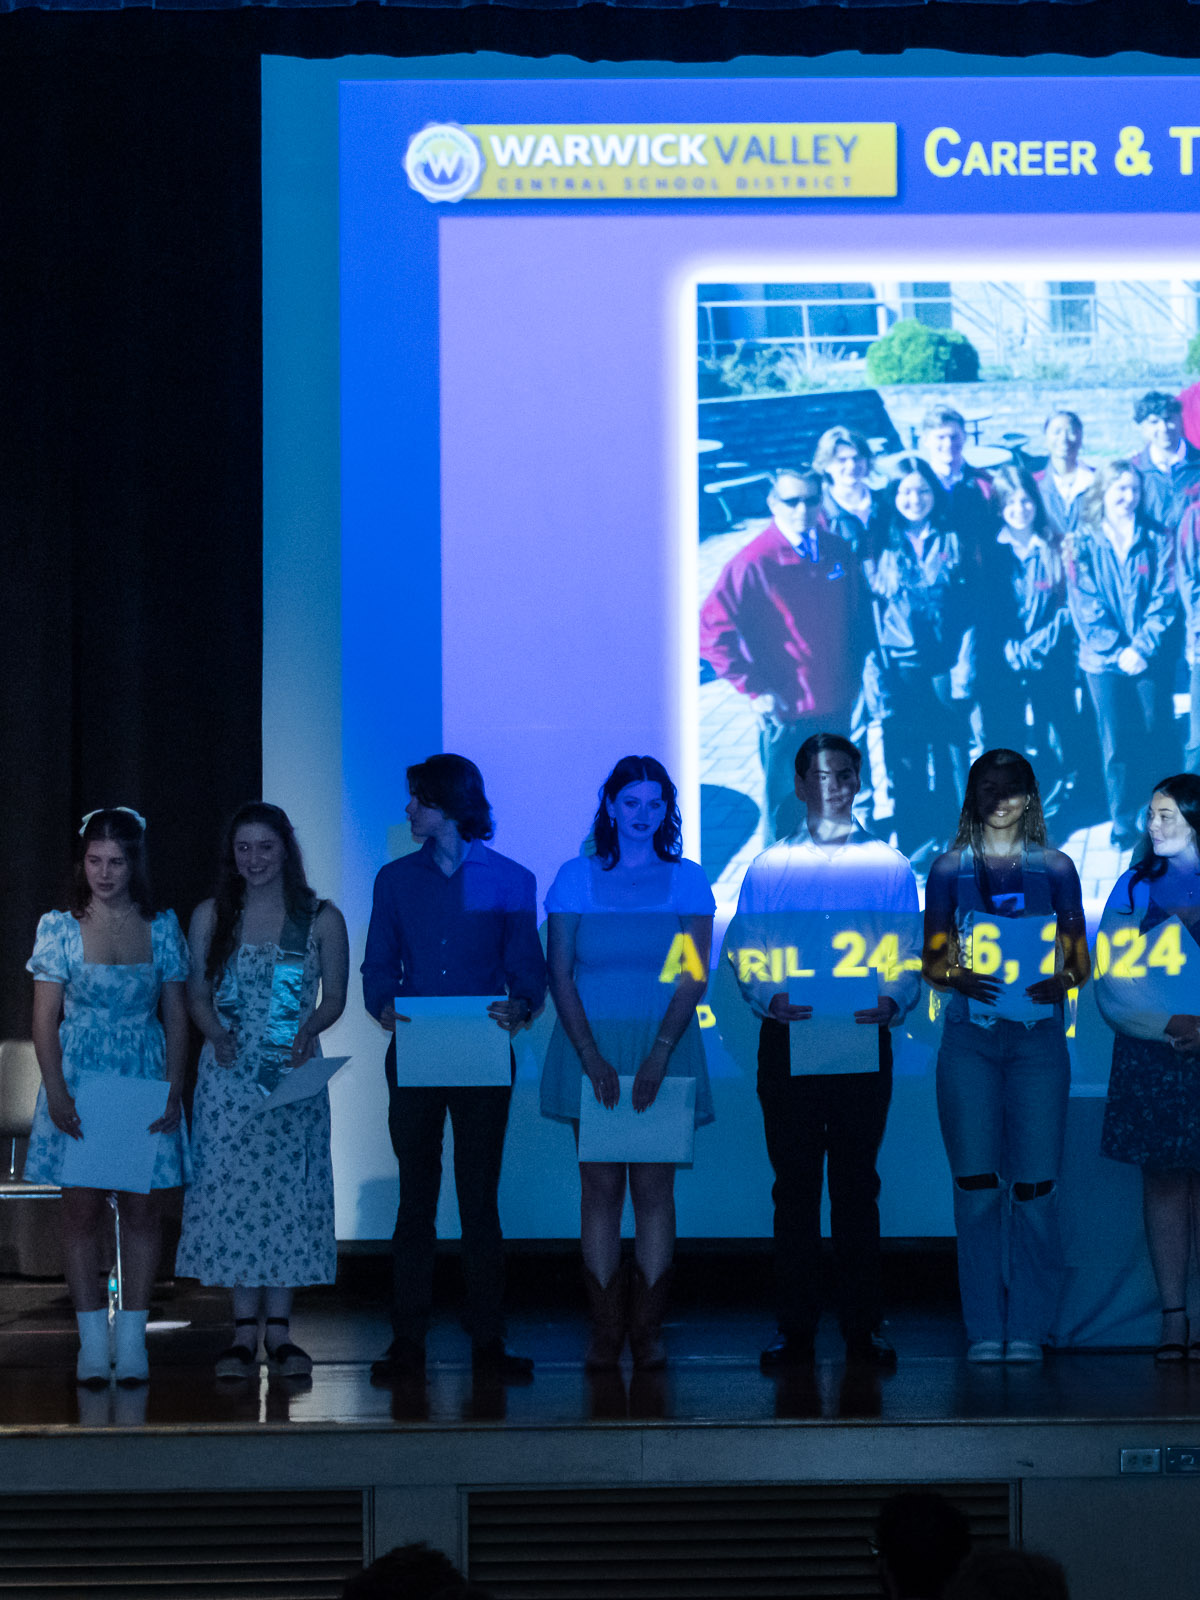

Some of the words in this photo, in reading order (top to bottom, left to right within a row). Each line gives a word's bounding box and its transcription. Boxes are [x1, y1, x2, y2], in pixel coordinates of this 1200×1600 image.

[489, 134, 707, 167] WARWICK
[713, 134, 859, 165] VALLEY
[924, 126, 1098, 177] CAREER
[1114, 126, 1154, 177] &
[497, 176, 607, 191] CENTRAL
[623, 175, 719, 191] SCHOOL
[736, 175, 852, 190] DISTRICT
